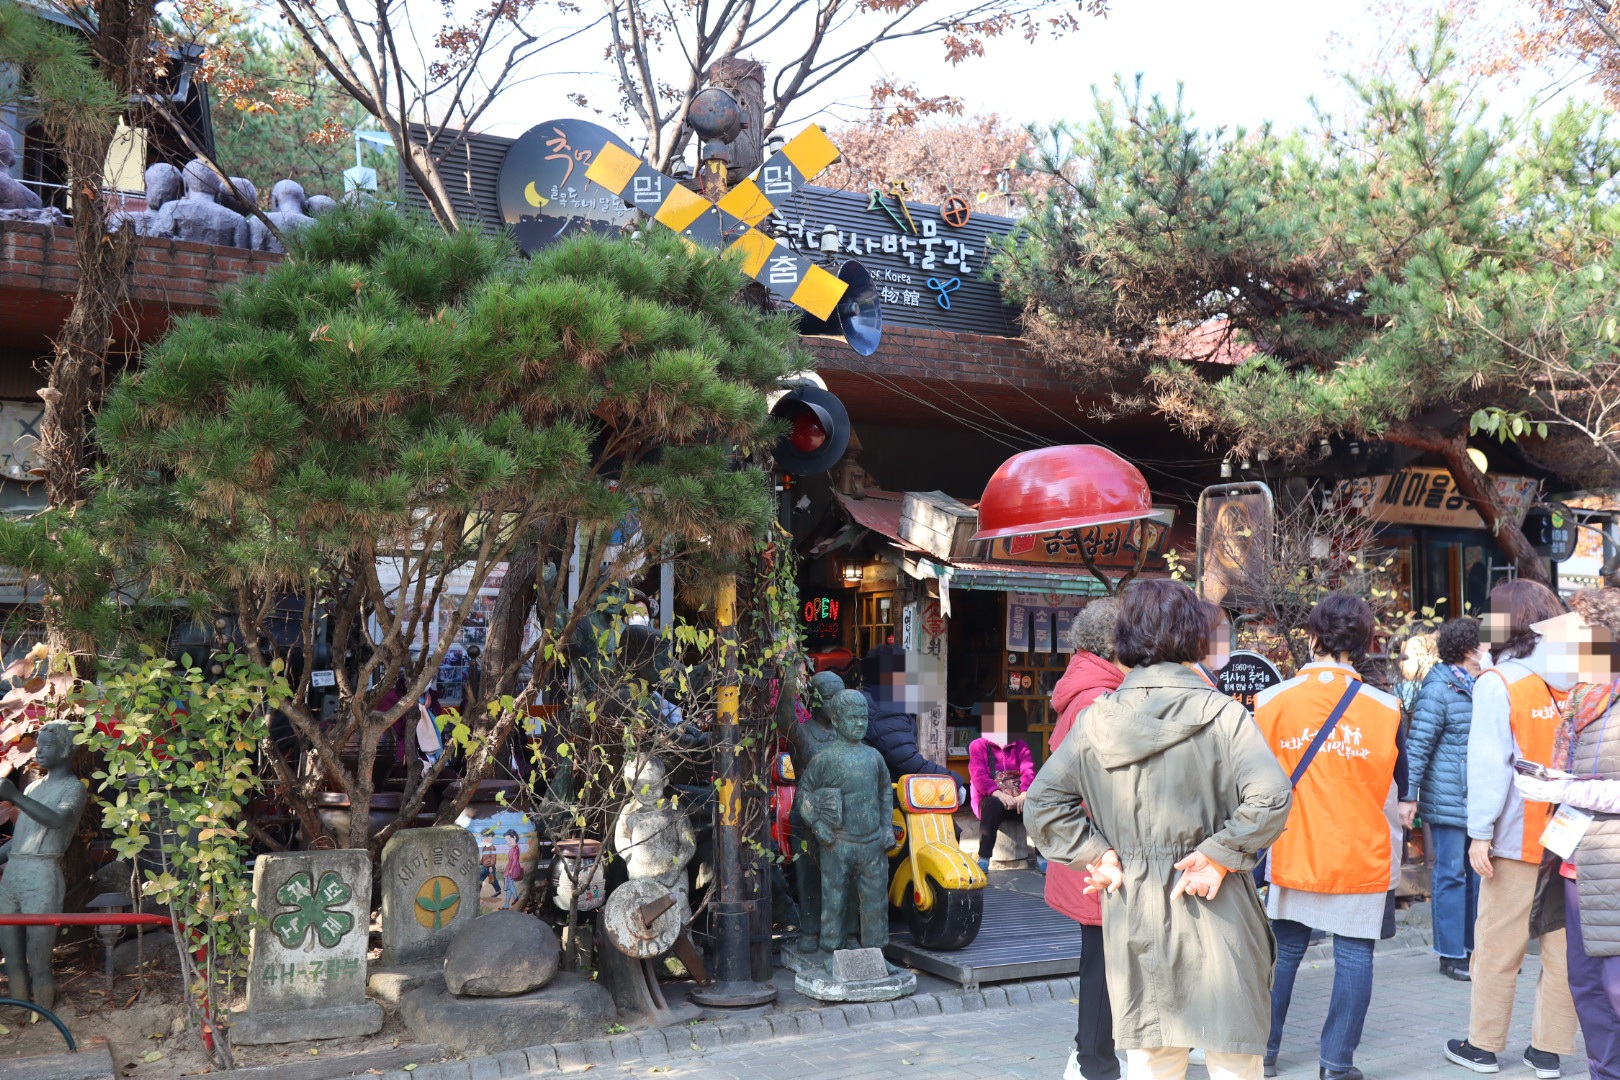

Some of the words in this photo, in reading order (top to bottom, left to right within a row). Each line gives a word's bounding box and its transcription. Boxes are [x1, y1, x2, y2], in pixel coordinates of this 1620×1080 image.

[764, 165, 792, 195] 멈
[633, 176, 662, 203] 멈
[769, 255, 798, 284] 춤
[884, 269, 912, 285] Korea
[804, 597, 839, 622] OPEN
[1220, 671, 1246, 684] 역사와
